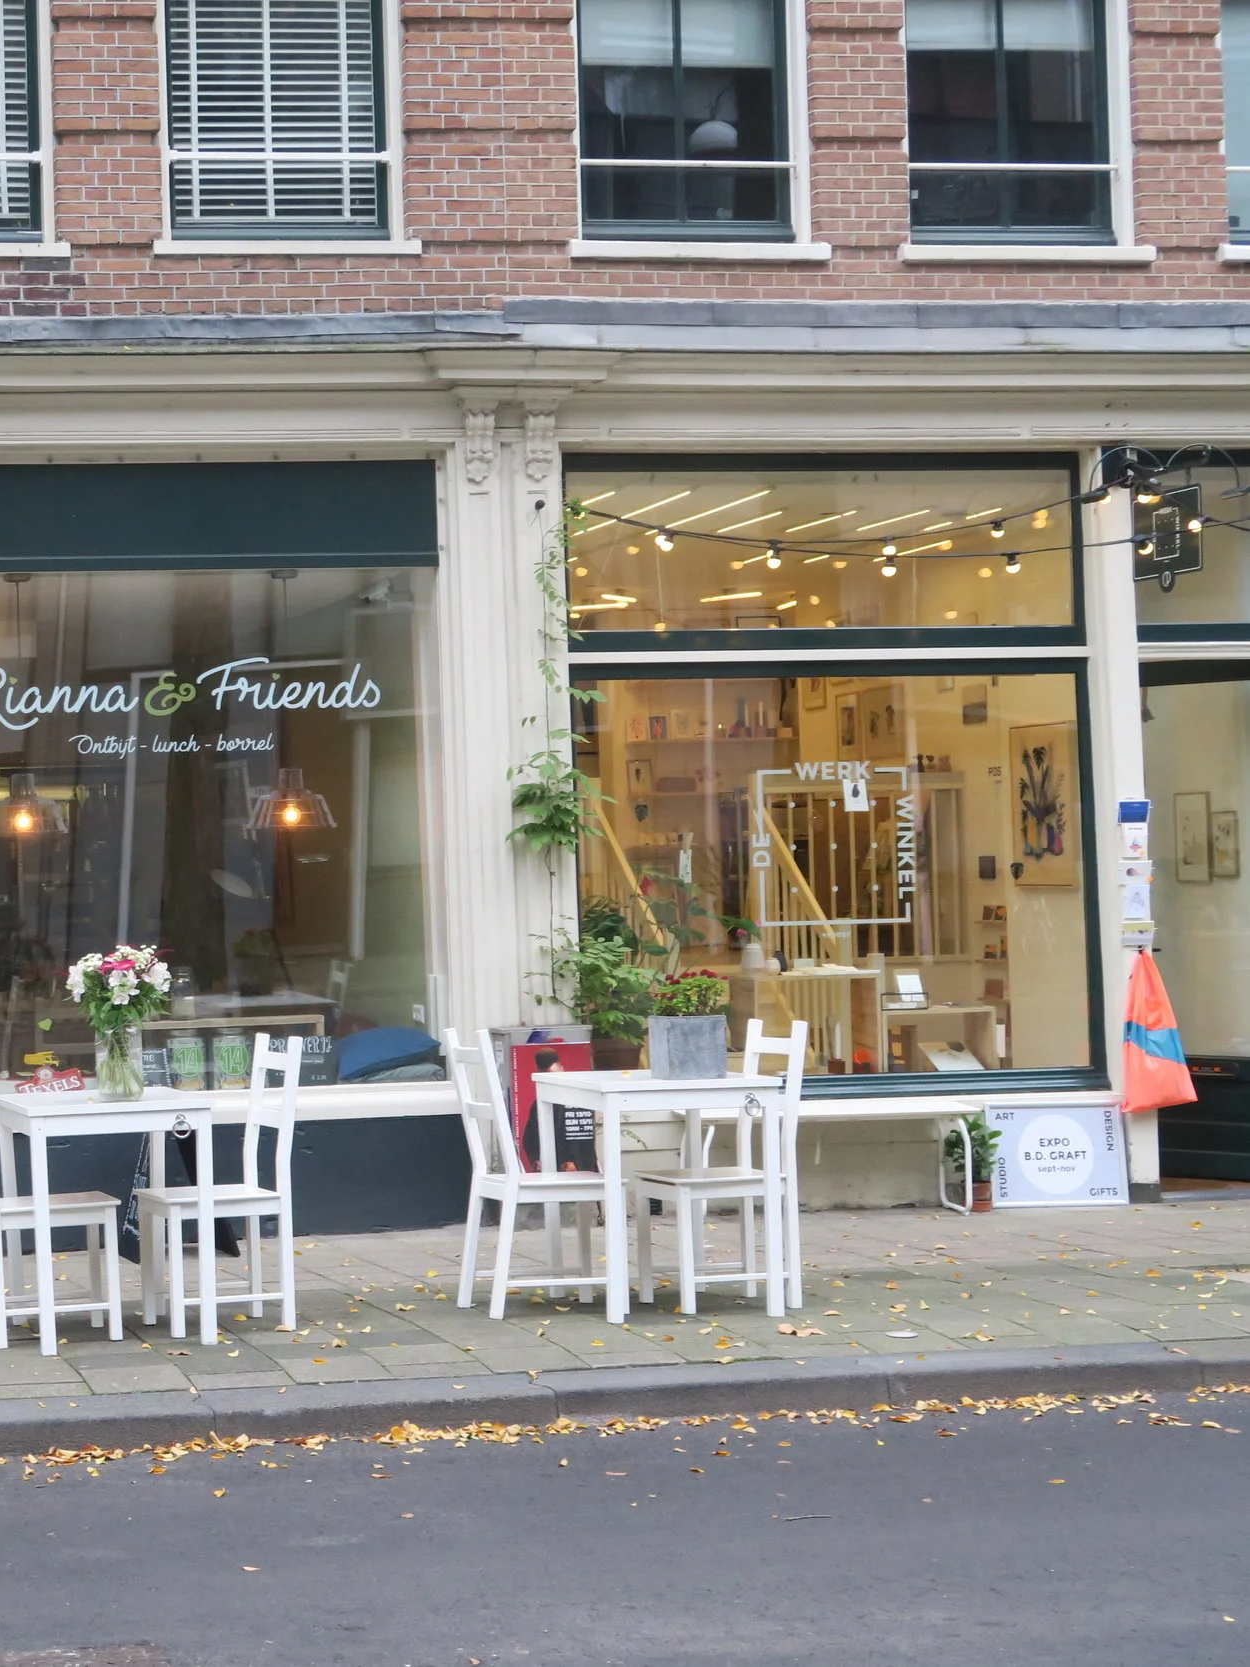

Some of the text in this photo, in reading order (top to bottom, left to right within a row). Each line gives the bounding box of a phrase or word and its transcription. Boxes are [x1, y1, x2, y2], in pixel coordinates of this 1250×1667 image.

[144, 672, 196, 716] &
[197, 657, 382, 711] Friends
[68, 734, 137, 759] Ontbijt
[153, 735, 200, 753] lunch
[216, 731, 275, 752] borrel
[795, 761, 871, 780] WERK
[752, 834, 771, 867] DE
[896, 795, 917, 899] WINKEL
[18, 1075, 81, 1094] TEXELS
[995, 1112, 1015, 1120] ART
[1103, 1111, 1114, 1151] DESIGN
[1039, 1138, 1070, 1147] EXPO
[1024, 1152, 1047, 1161] B.D.
[998, 1157, 1008, 1198] STUDIO
[1037, 1164, 1076, 1173] sept-nov
[1089, 1188, 1118, 1197] GIFTS
